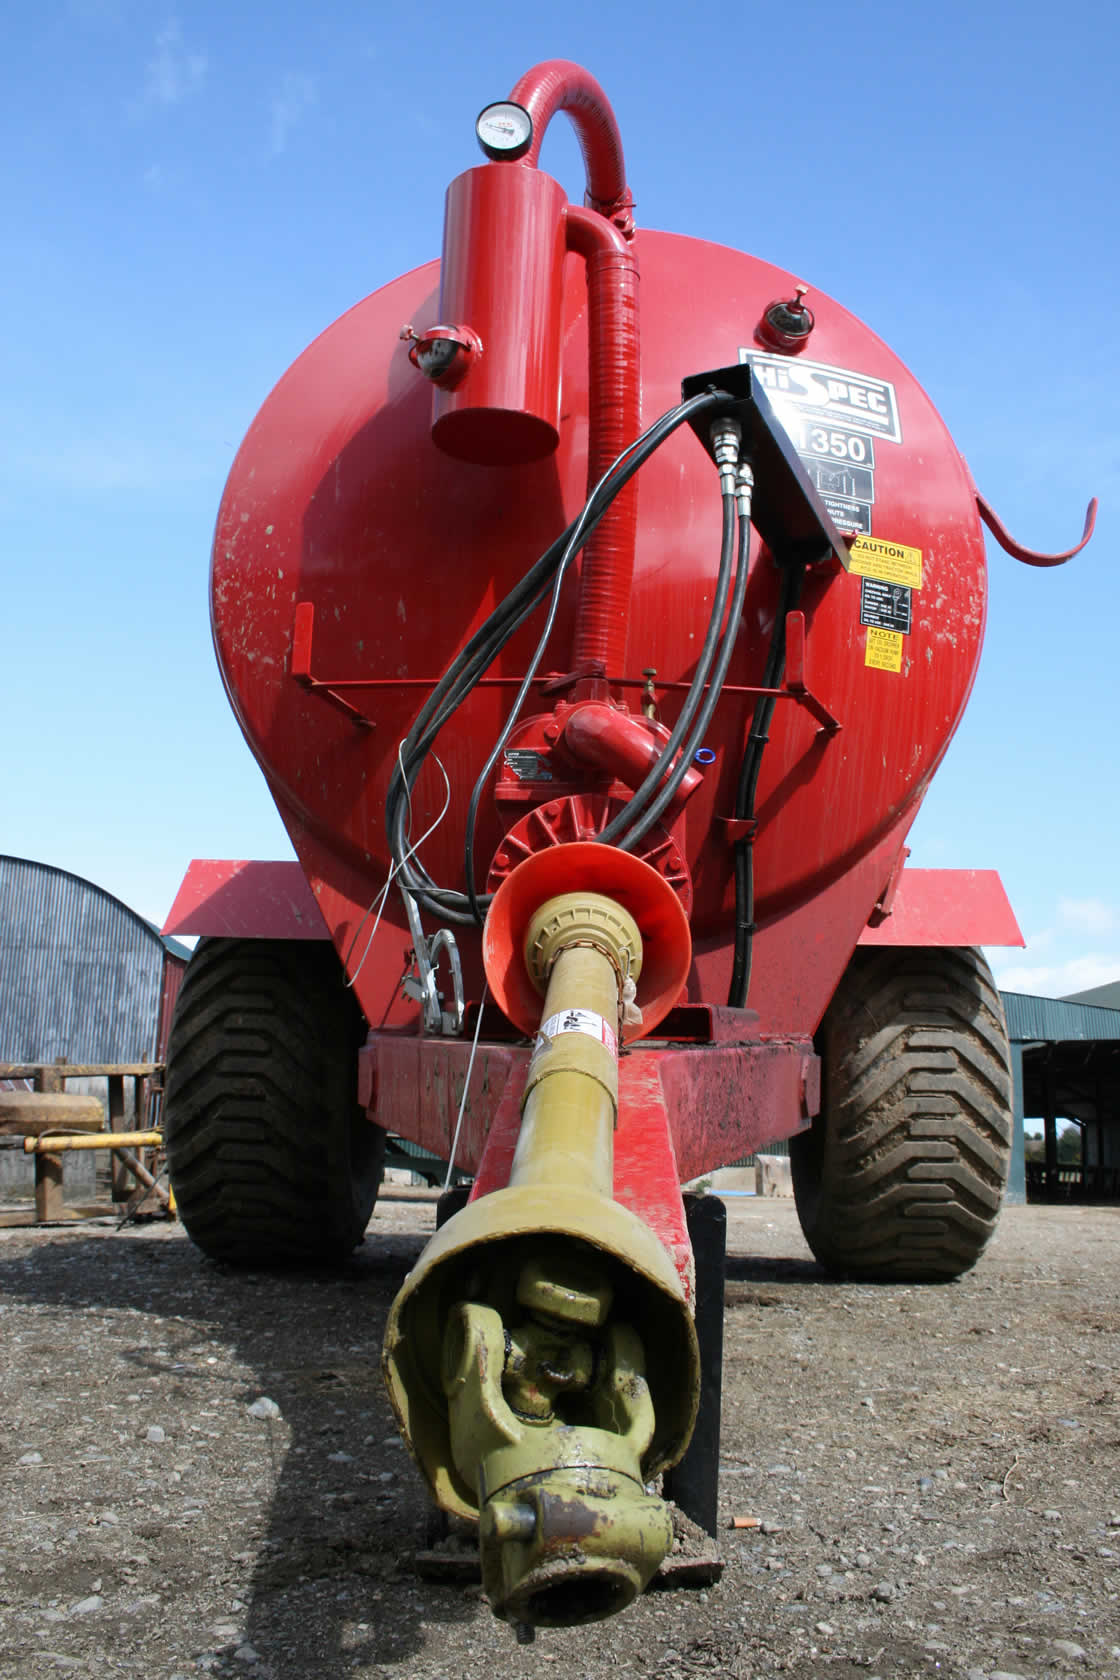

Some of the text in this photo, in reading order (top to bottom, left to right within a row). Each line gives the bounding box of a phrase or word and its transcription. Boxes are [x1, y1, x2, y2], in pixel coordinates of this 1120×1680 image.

[797, 423, 866, 461] 1350
[824, 500, 860, 512] TIGHTNESS
[854, 539, 905, 559] CAUTION
[870, 629, 900, 641] NOTE
